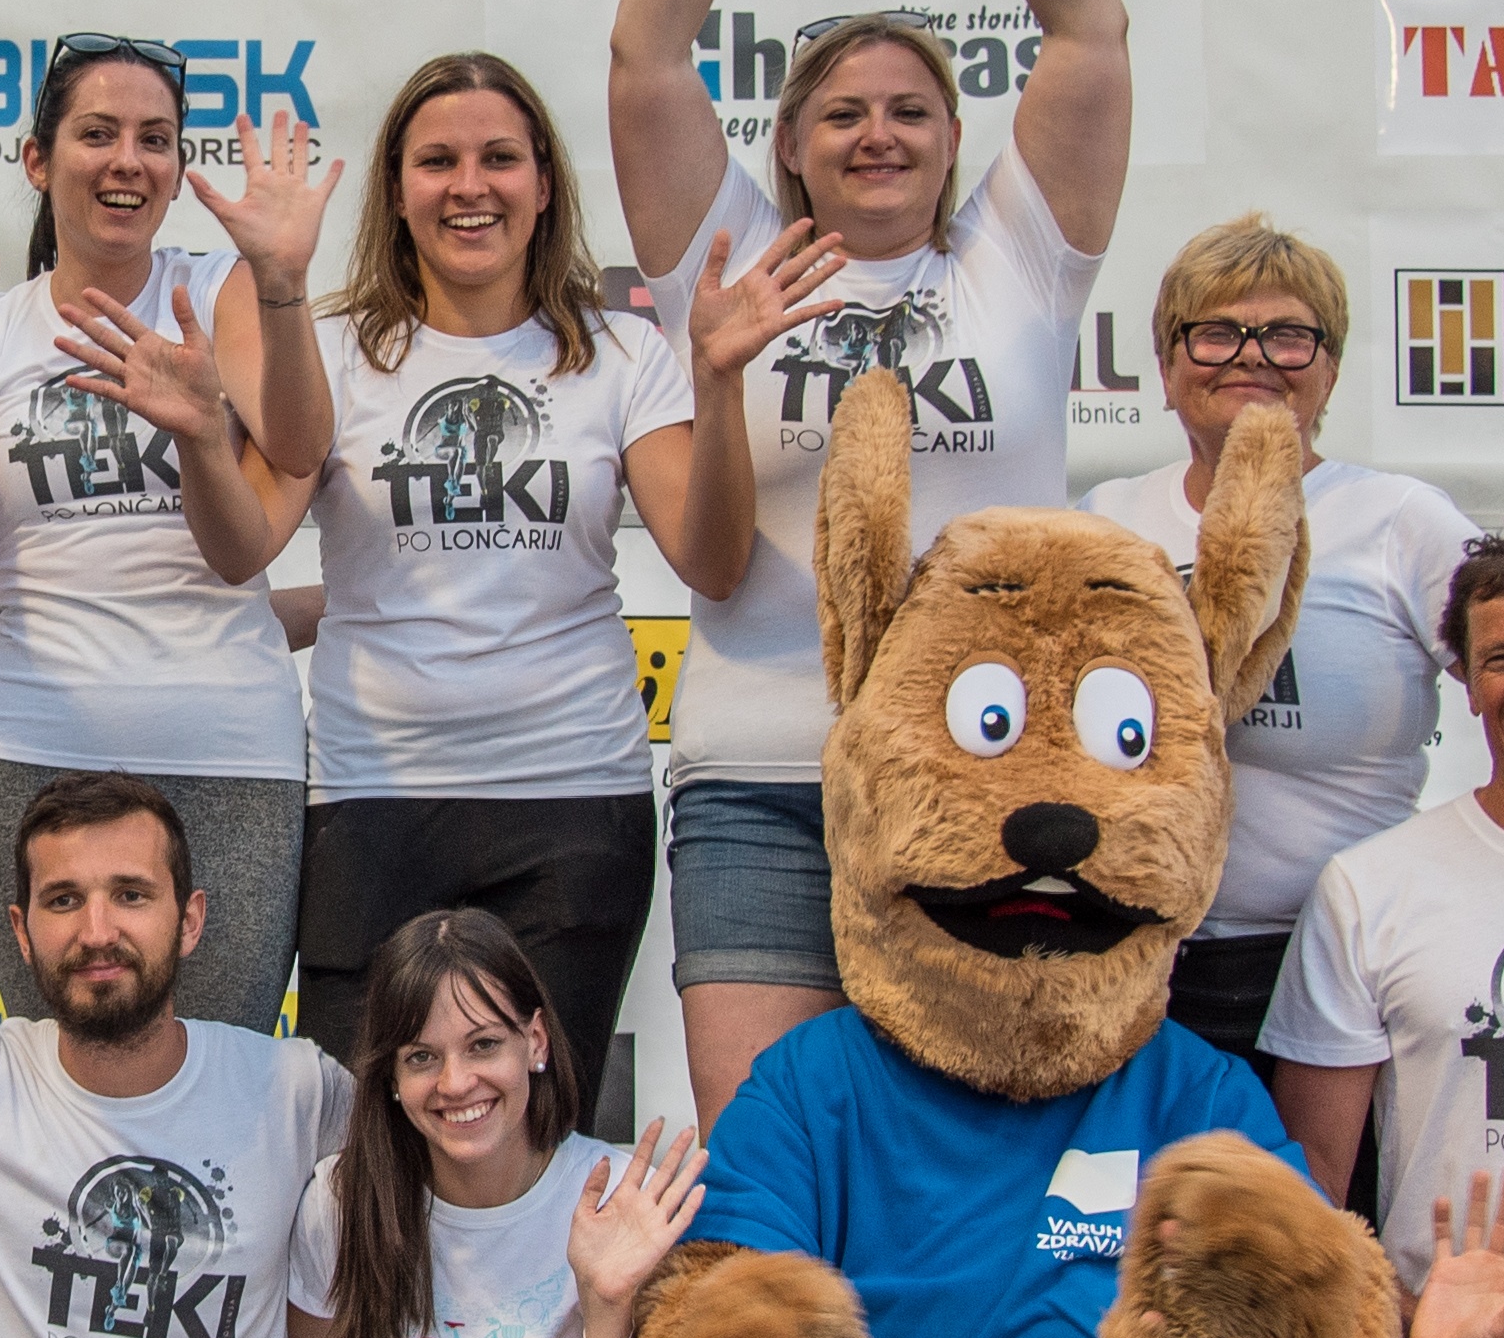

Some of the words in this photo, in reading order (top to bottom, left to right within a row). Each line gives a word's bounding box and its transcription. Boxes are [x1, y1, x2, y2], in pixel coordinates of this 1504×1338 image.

[1072, 401, 1141, 424] ibnica
[780, 429, 825, 451] PO
[371, 459, 571, 528] TEKI
[397, 530, 432, 554] PO
[441, 524, 563, 551] LONČARIJI
[1047, 1216, 1123, 1240] VARUH
